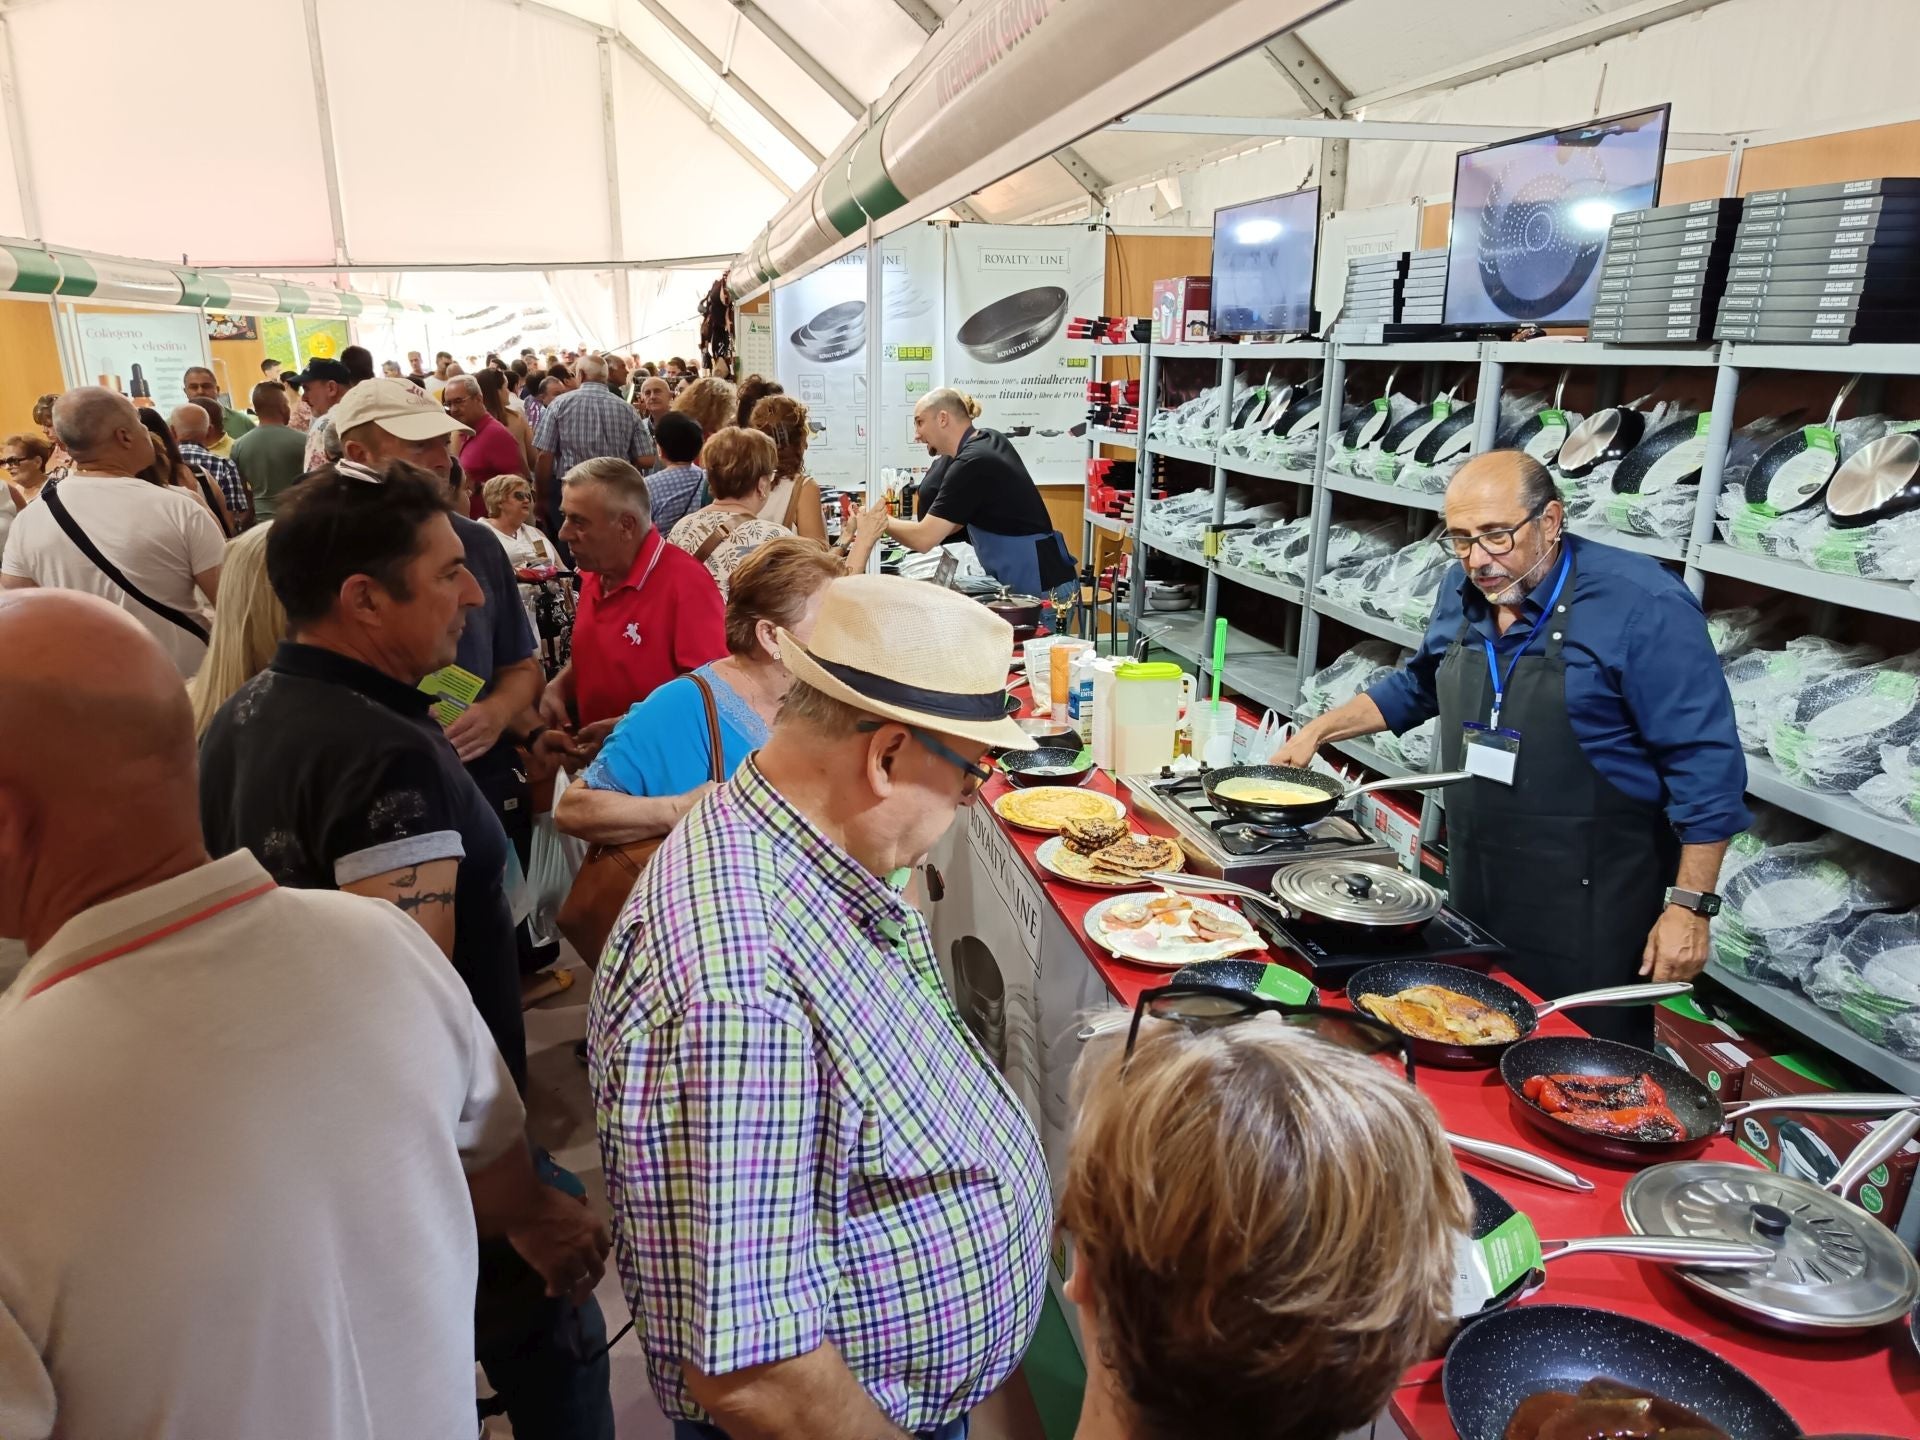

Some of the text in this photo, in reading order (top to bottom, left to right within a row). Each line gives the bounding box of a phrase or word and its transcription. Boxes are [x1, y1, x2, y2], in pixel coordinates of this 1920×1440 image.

[1377, 241, 1394, 252] LINE
[882, 255, 901, 265] INE
[984, 254, 1065, 265] ROYALTY LINE
[142, 341, 188, 352] elastina
[996, 336, 1040, 359] ROYALTY LINE
[999, 388, 1033, 399] titanio
[969, 805, 1006, 880] ROYALTY
